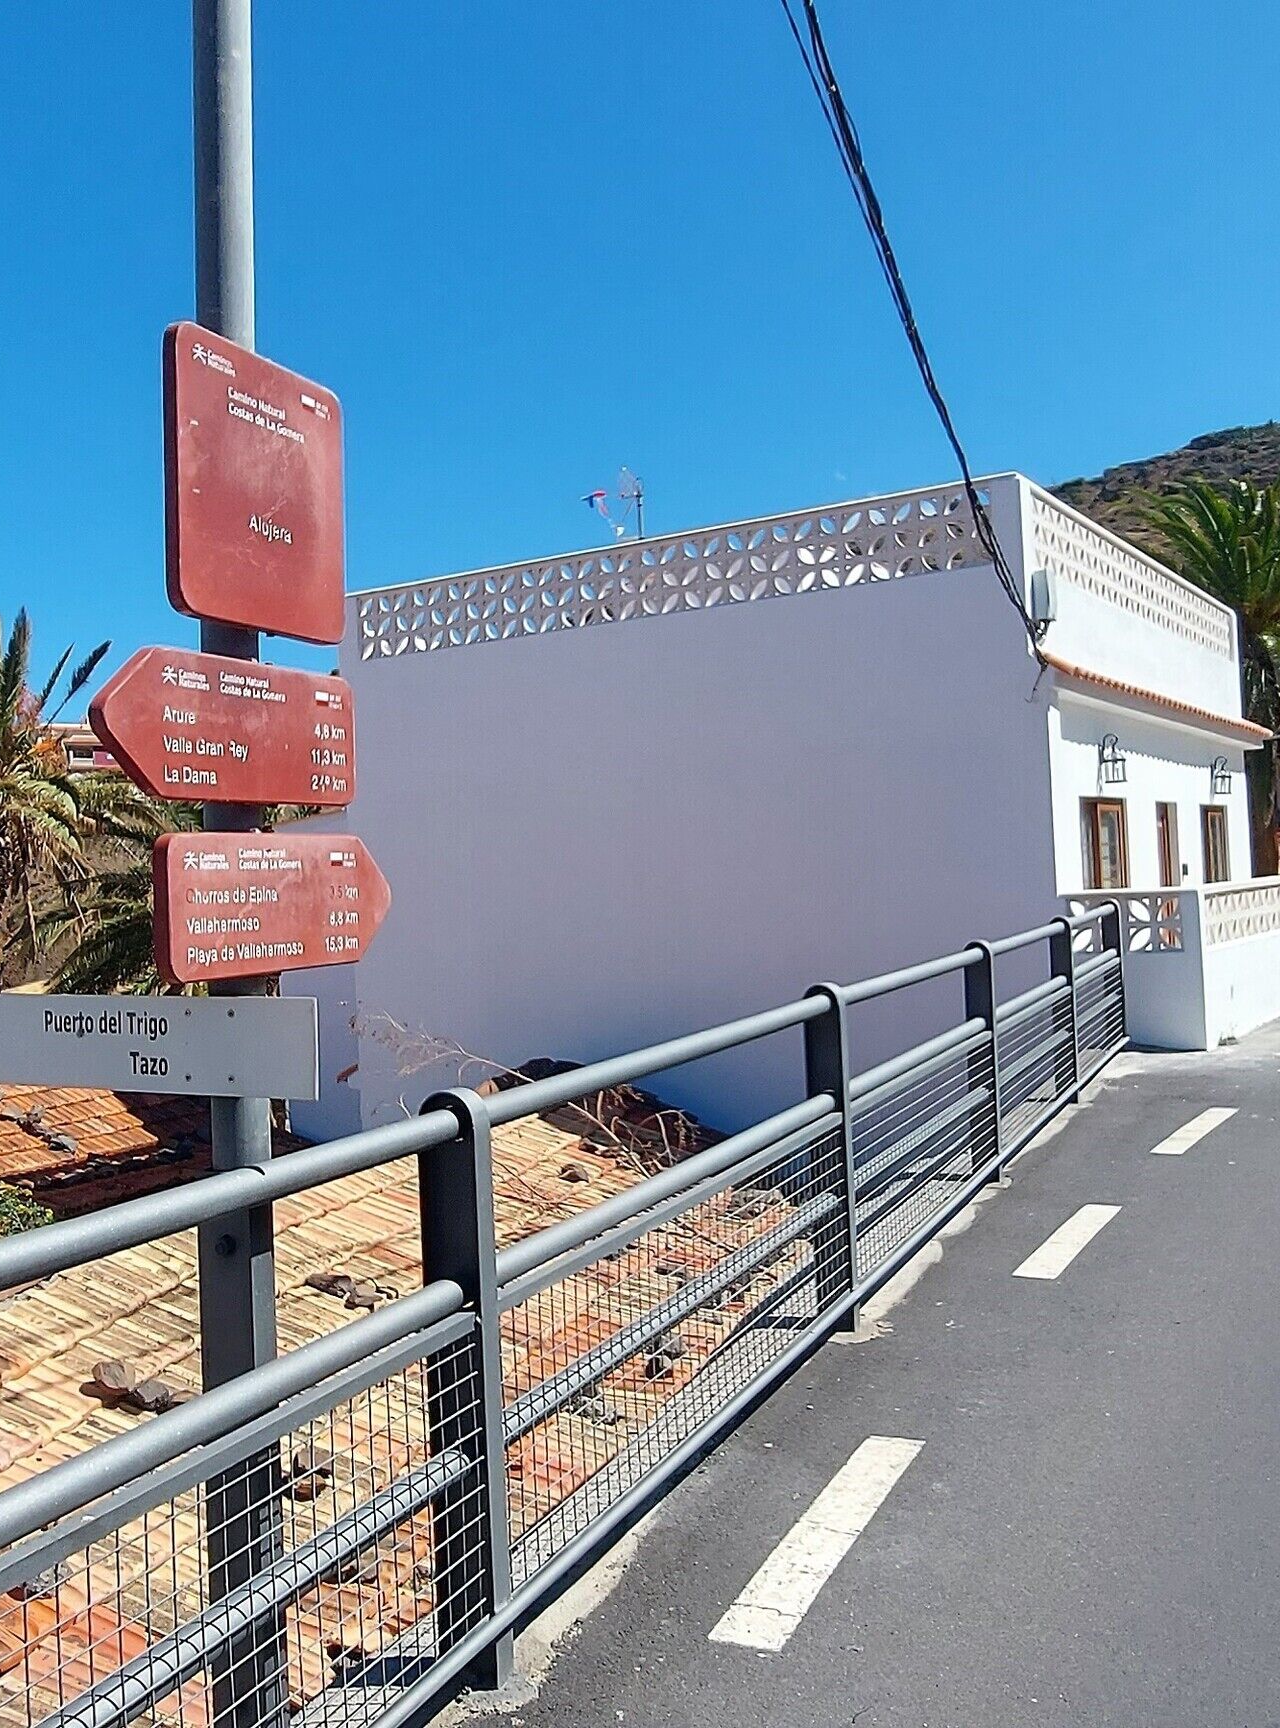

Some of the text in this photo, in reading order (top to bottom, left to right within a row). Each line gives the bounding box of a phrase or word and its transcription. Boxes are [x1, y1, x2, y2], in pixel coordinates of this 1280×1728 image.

[227, 386, 286, 421] Camino Natural
[228, 403, 305, 444] Costas de La Gomera
[249, 514, 293, 545] Alojera
[220, 671, 270, 689] Camino Natural
[220, 683, 287, 703] Costas de La Gomera
[163, 706, 197, 725] Arure
[315, 723, 346, 740] 4,8 km
[163, 735, 249, 762] Valle Gran Rey
[311, 748, 346, 767] 11,3 km
[164, 765, 218, 785] La Dama
[238, 848, 286, 858] Camino Natural
[239, 859, 302, 870] Costas de La Gomera
[186, 885, 279, 904] Chorros de Epina
[186, 916, 260, 935] Vallehermoso
[344, 910, 359, 925] km
[324, 935, 359, 953] 15,3 km
[187, 941, 304, 967] Playa de Vallehermoso
[43, 1010, 169, 1041] Puerto del Trigo
[129, 1051, 169, 1076] Tazo
